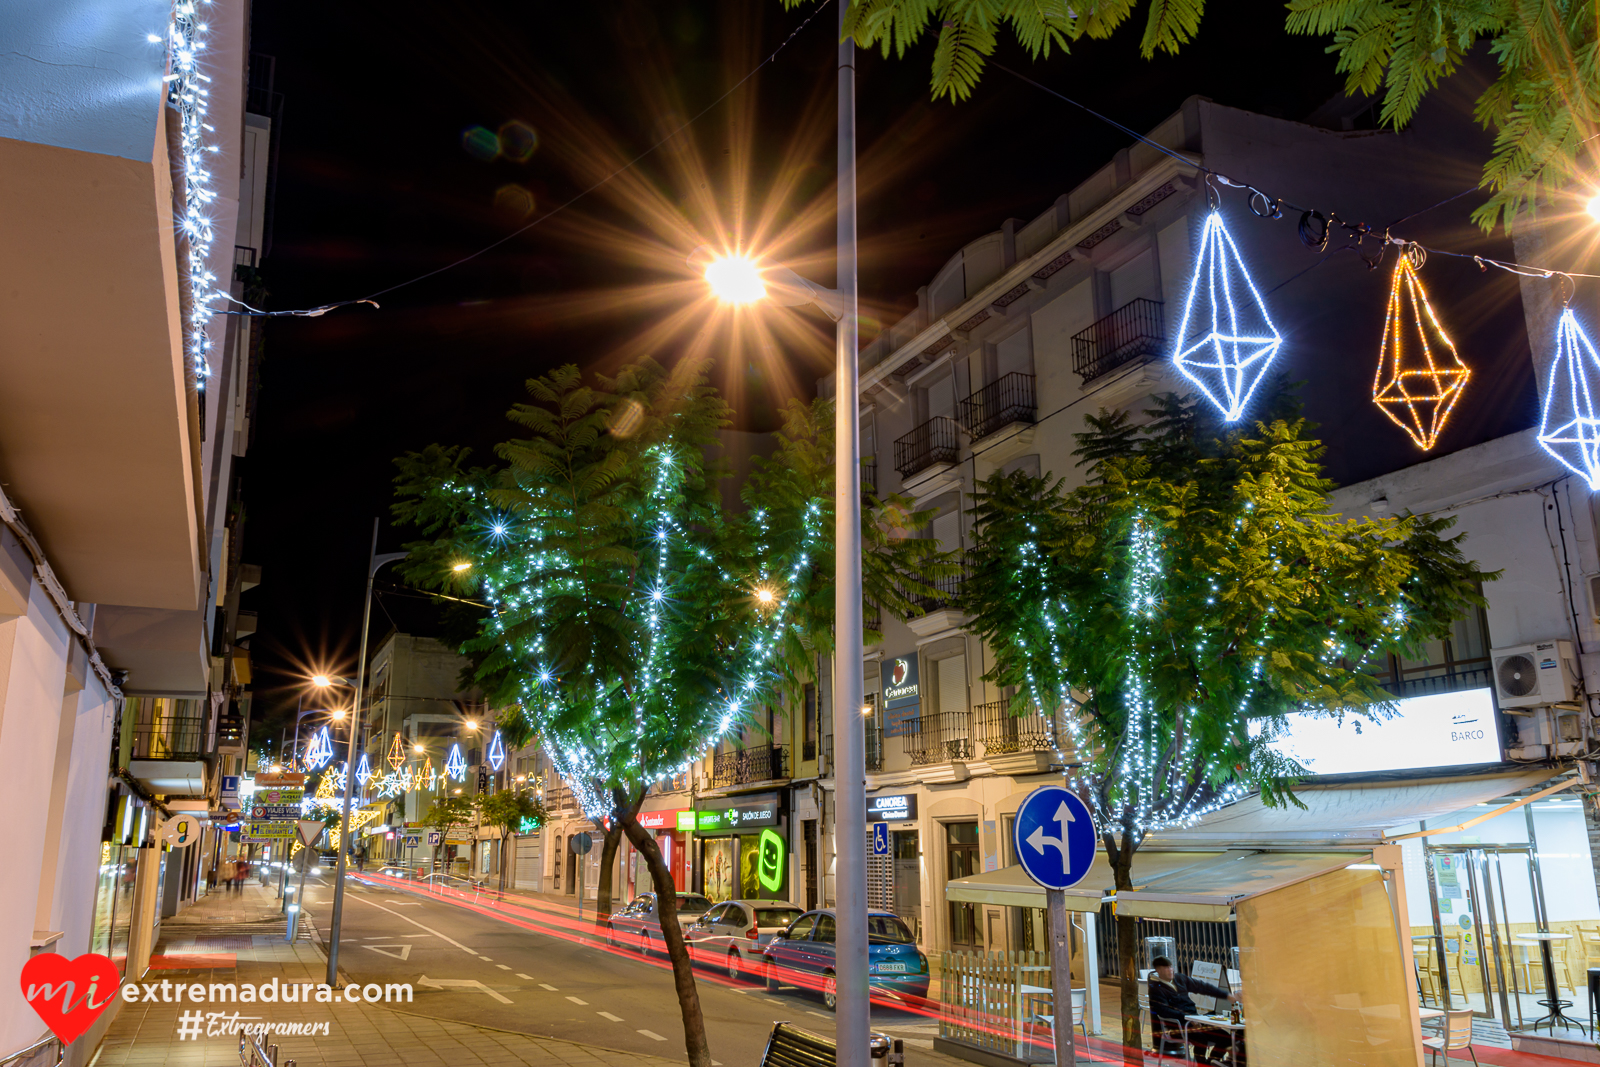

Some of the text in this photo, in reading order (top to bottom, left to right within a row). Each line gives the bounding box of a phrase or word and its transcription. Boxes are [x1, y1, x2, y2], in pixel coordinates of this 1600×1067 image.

[1451, 729, 1484, 742] BARCO
[225, 778, 235, 790] L
[875, 795, 908, 808] CANOREA
[645, 814, 664, 827] Santander
[251, 824, 260, 834] H
